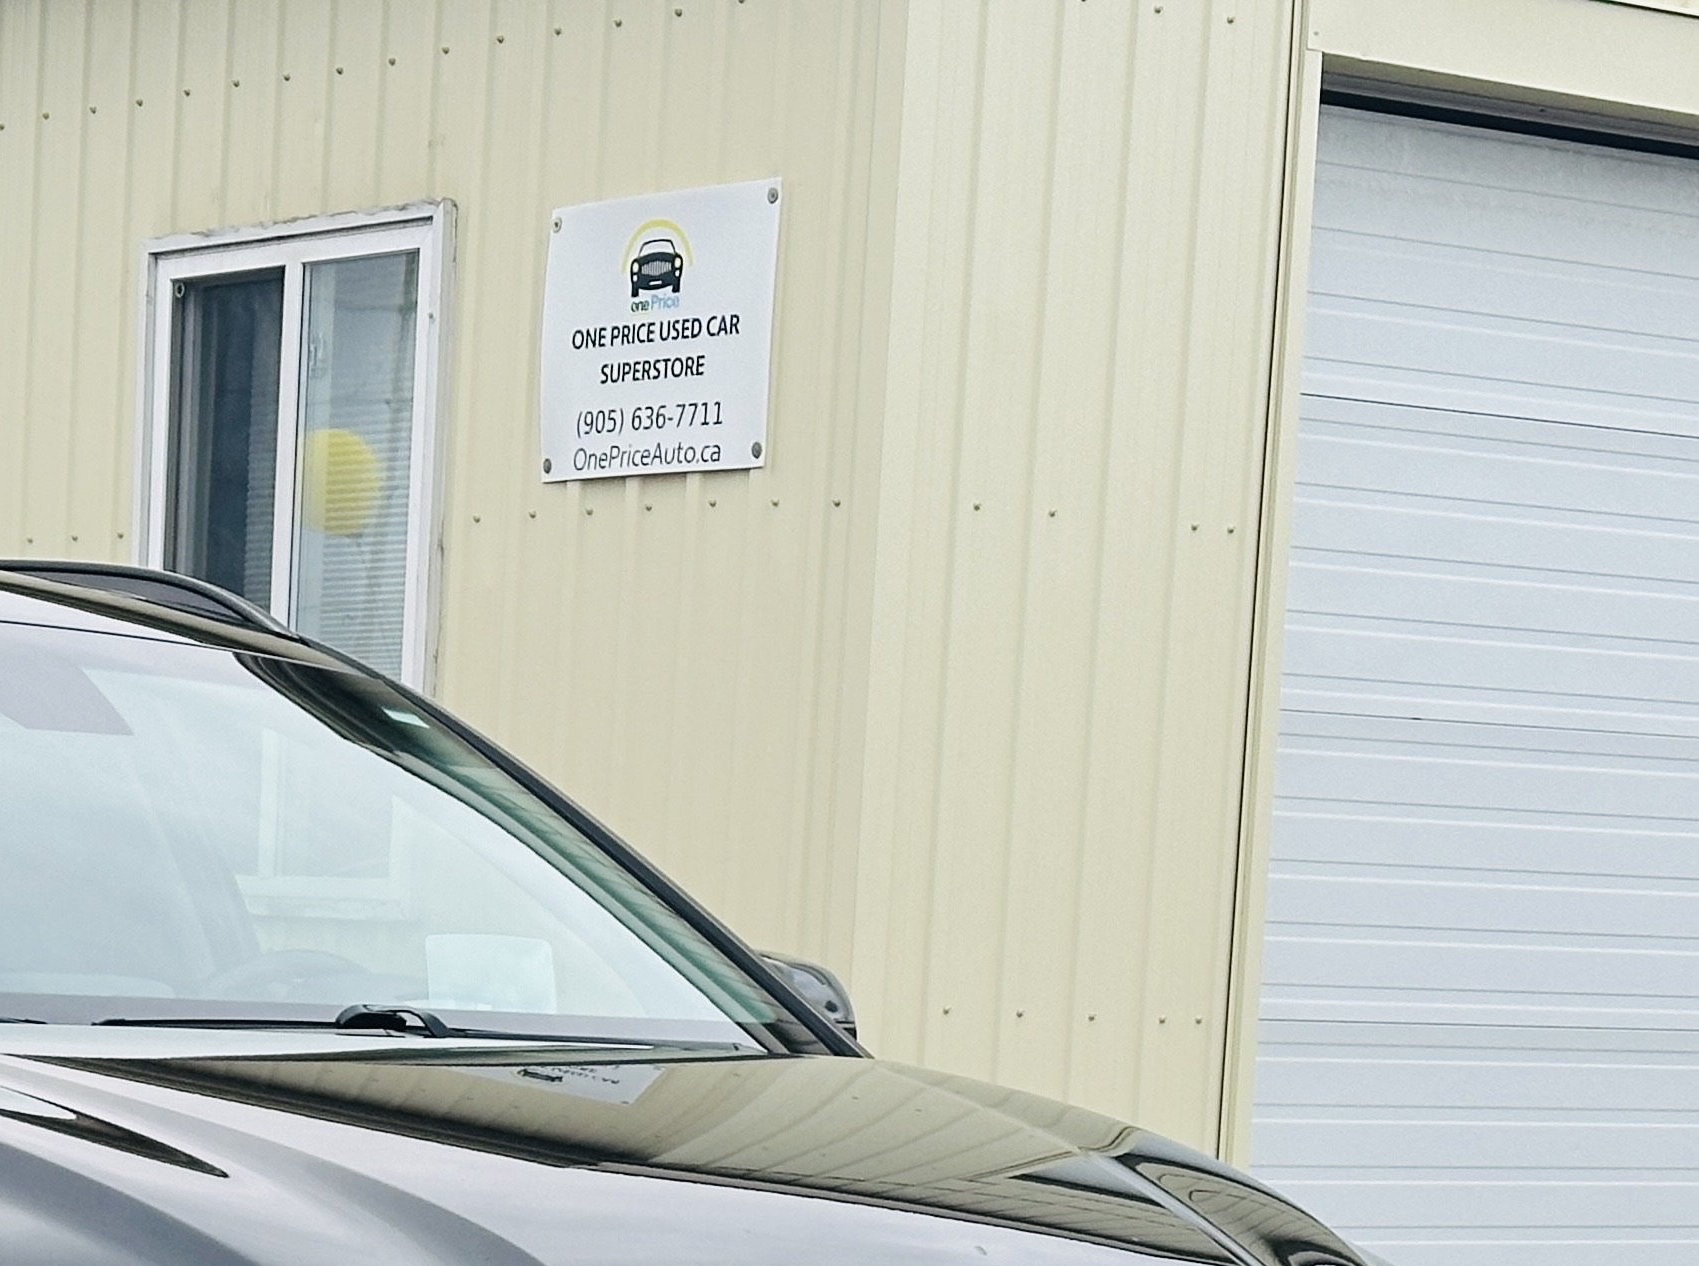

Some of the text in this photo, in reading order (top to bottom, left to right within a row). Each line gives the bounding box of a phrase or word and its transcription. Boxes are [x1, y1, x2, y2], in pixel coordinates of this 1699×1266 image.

[572, 314, 740, 350] ONE PRICE USED CAR
[600, 355, 705, 384] SUPERSTORE
[576, 401, 723, 438] (905) 636-7711
[573, 442, 721, 472] OnePriceAuto.ca
